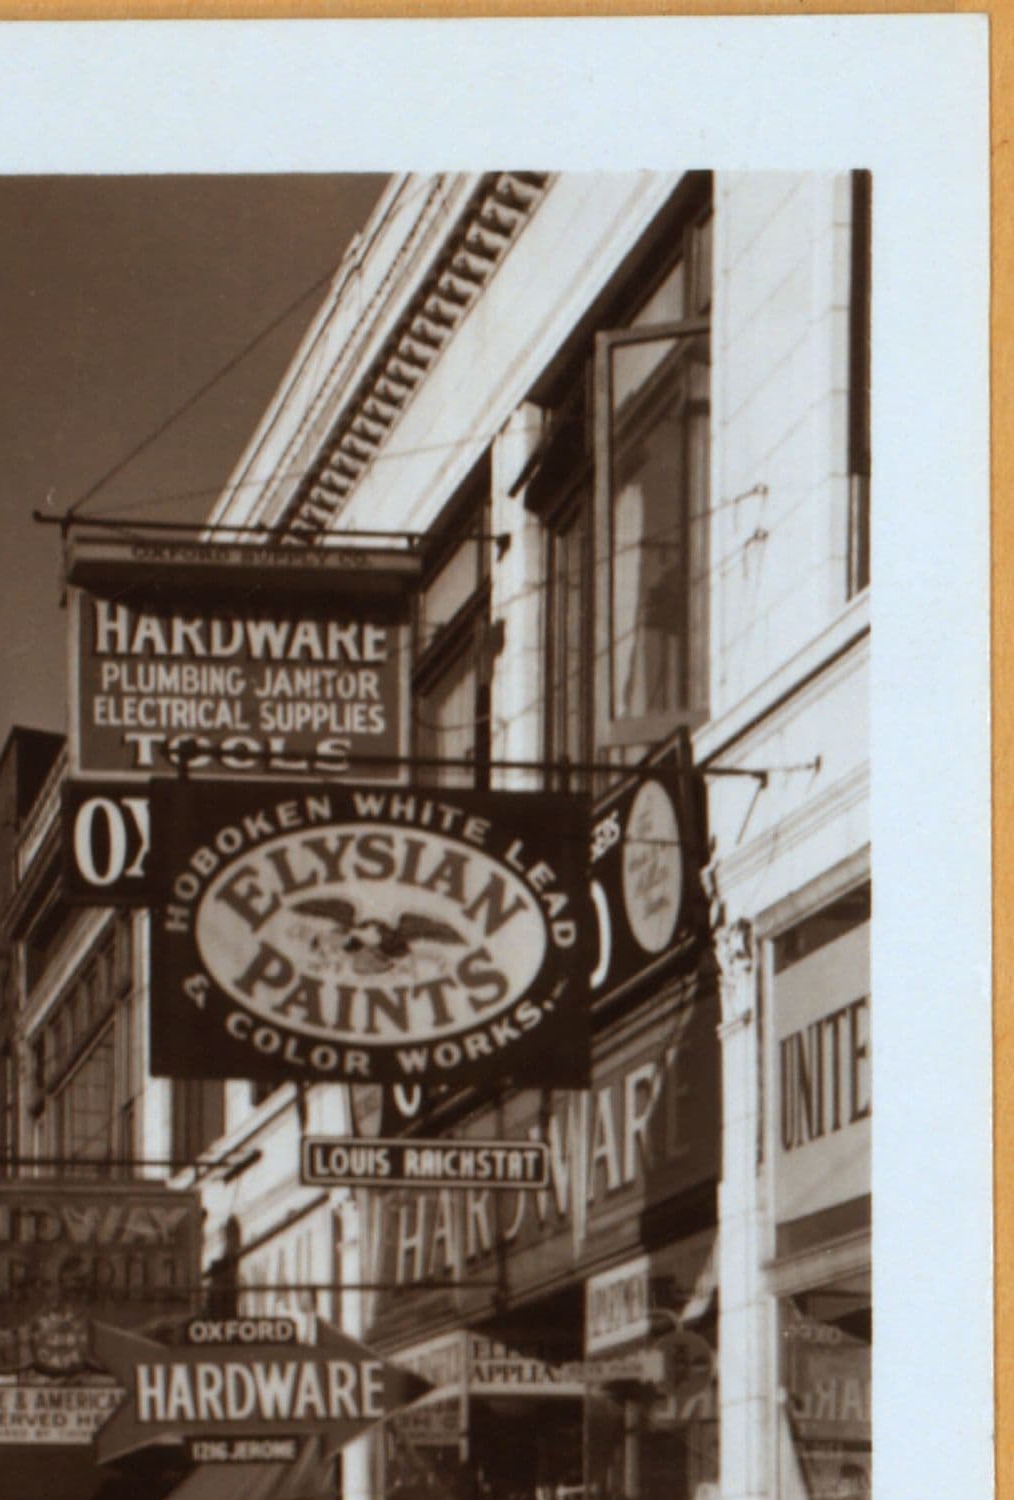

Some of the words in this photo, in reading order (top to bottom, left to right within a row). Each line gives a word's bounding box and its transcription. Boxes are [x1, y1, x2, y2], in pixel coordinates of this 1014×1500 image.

[94, 600, 388, 662] HARDWARE
[100, 661, 246, 697] PLUMBING
[254, 668, 380, 701] JANITOR
[92, 697, 250, 732] ELECTRICAL
[259, 703, 386, 735] SUPPLIES
[123, 732, 352, 772] TOOLS
[165, 794, 331, 933] HOBOKEN
[353, 792, 491, 846] WHITE
[505, 839, 577, 949] LEAD
[214, 833, 529, 936] ELYSIAN
[232, 940, 510, 1034] PAINTS
[225, 1011, 371, 1076] COLOR
[314, 1146, 391, 1178] LOUIS
[188, 1319, 294, 1344] OXFORD
[136, 1359, 385, 1423] HARDWARE
